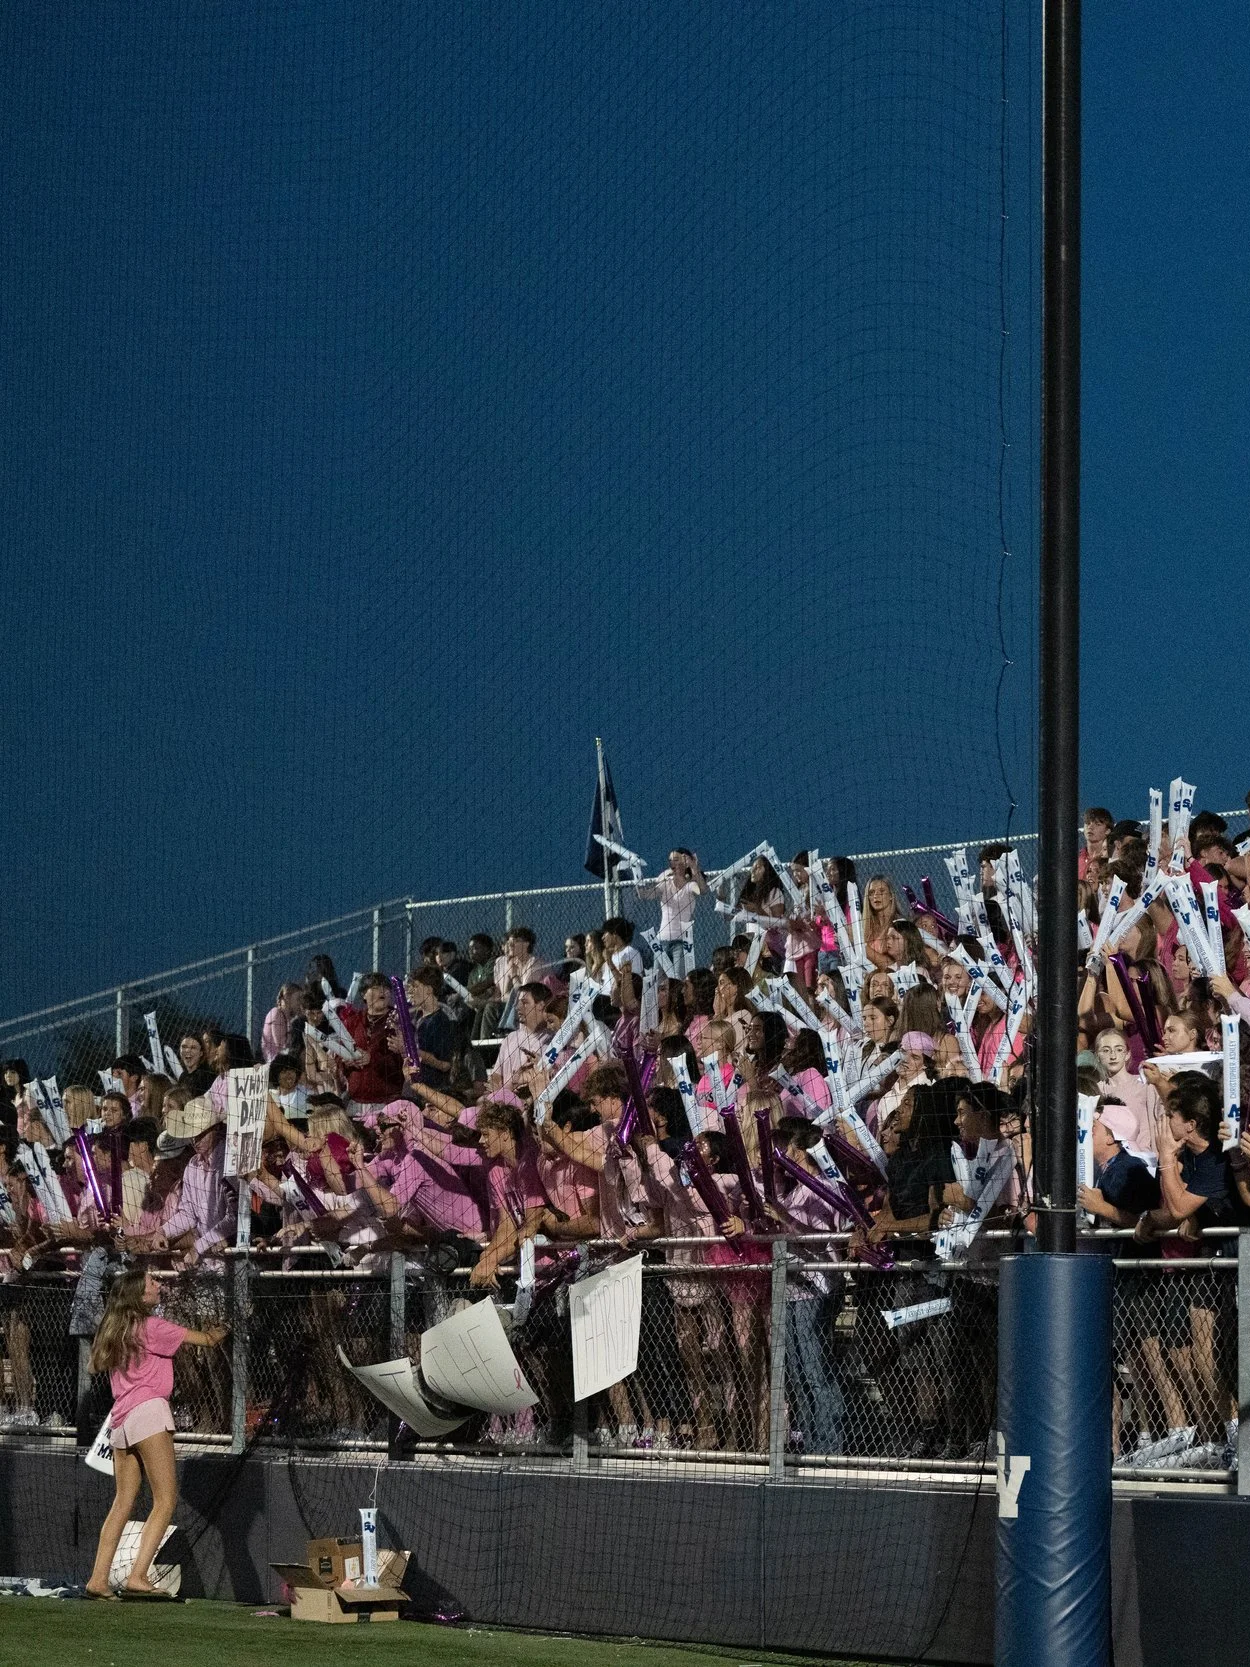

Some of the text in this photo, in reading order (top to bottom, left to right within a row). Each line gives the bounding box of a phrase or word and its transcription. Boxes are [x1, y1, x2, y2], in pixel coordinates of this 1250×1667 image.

[1207, 906, 1219, 922] SV
[968, 966, 984, 979] SV
[826, 1057, 839, 1073] SV
